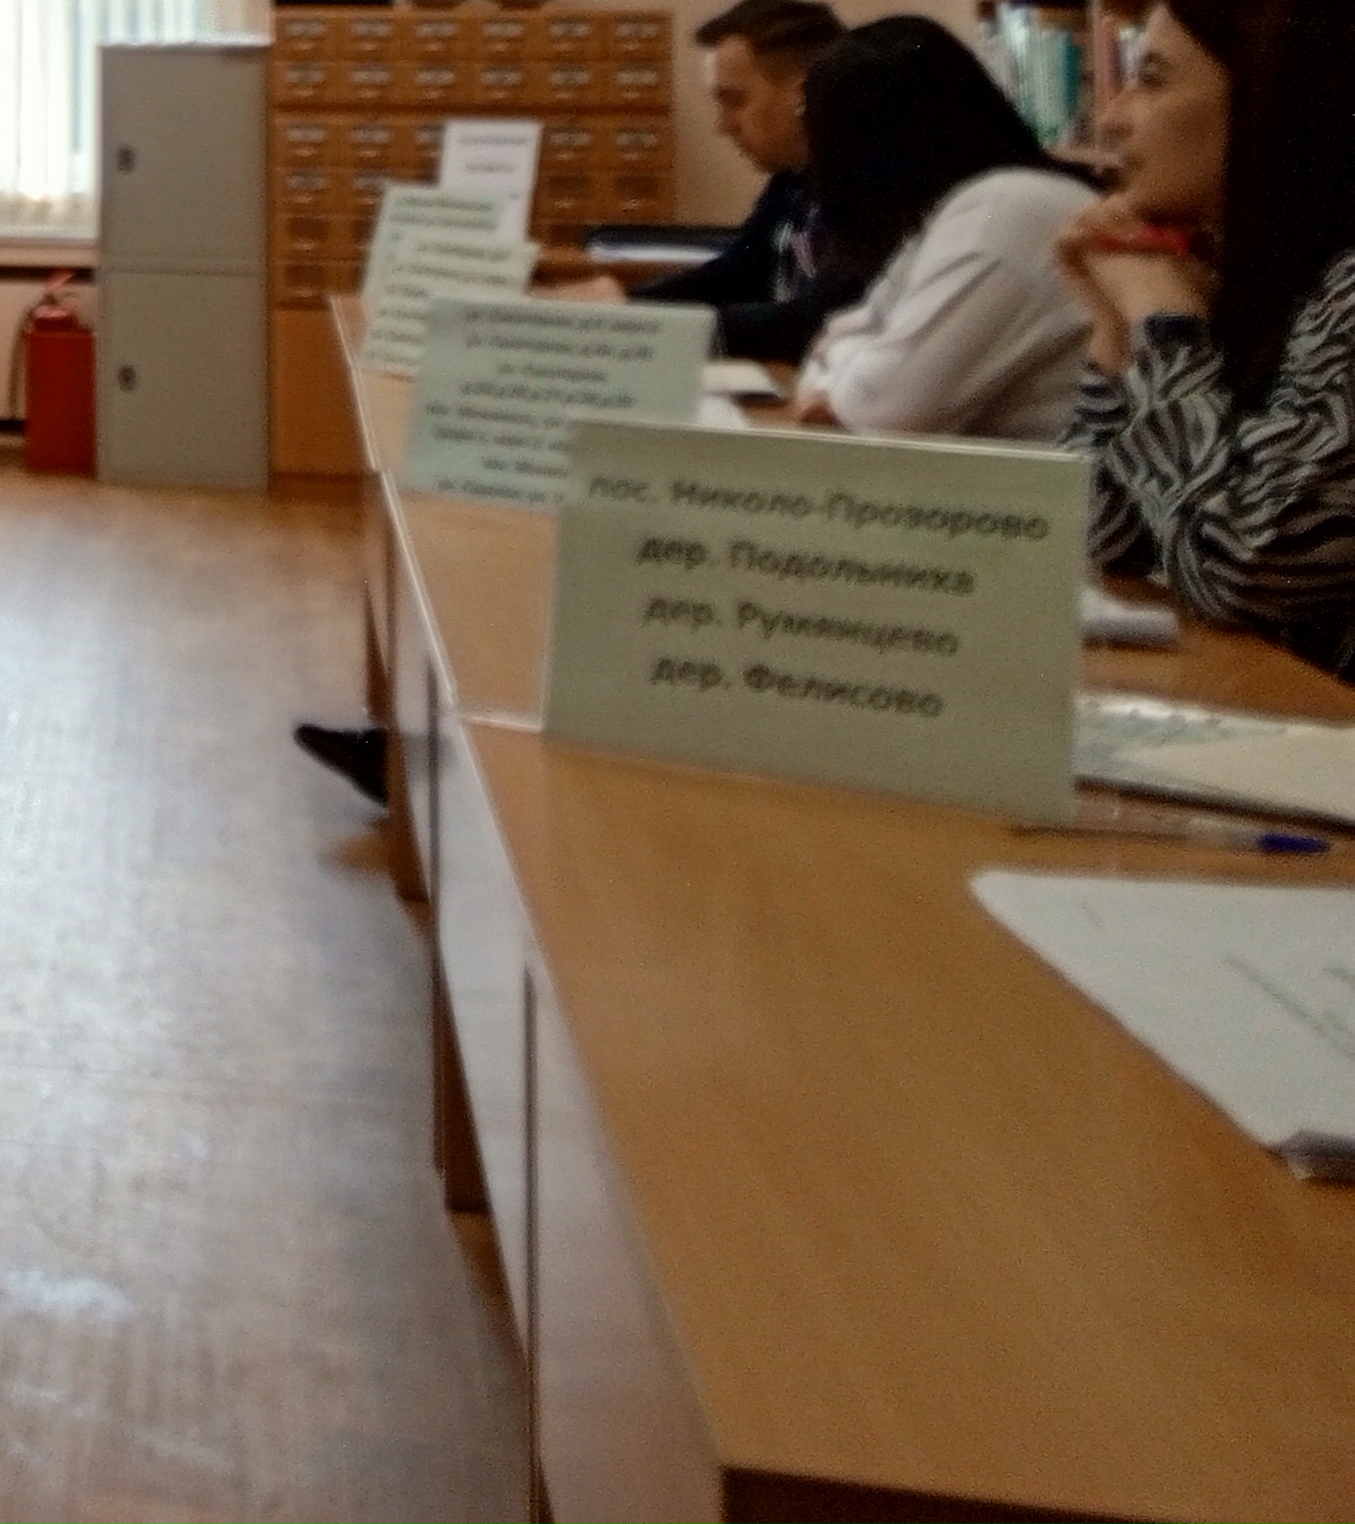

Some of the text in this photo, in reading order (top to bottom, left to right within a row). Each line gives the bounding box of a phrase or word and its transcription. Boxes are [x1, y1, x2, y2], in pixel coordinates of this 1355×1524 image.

[588, 477, 656, 506] пос.
[670, 478, 1050, 542] Николо-Прозорово
[635, 535, 716, 569] дер.
[642, 597, 960, 656] дер. Румянцево
[650, 656, 945, 719] дер. Фелисово
